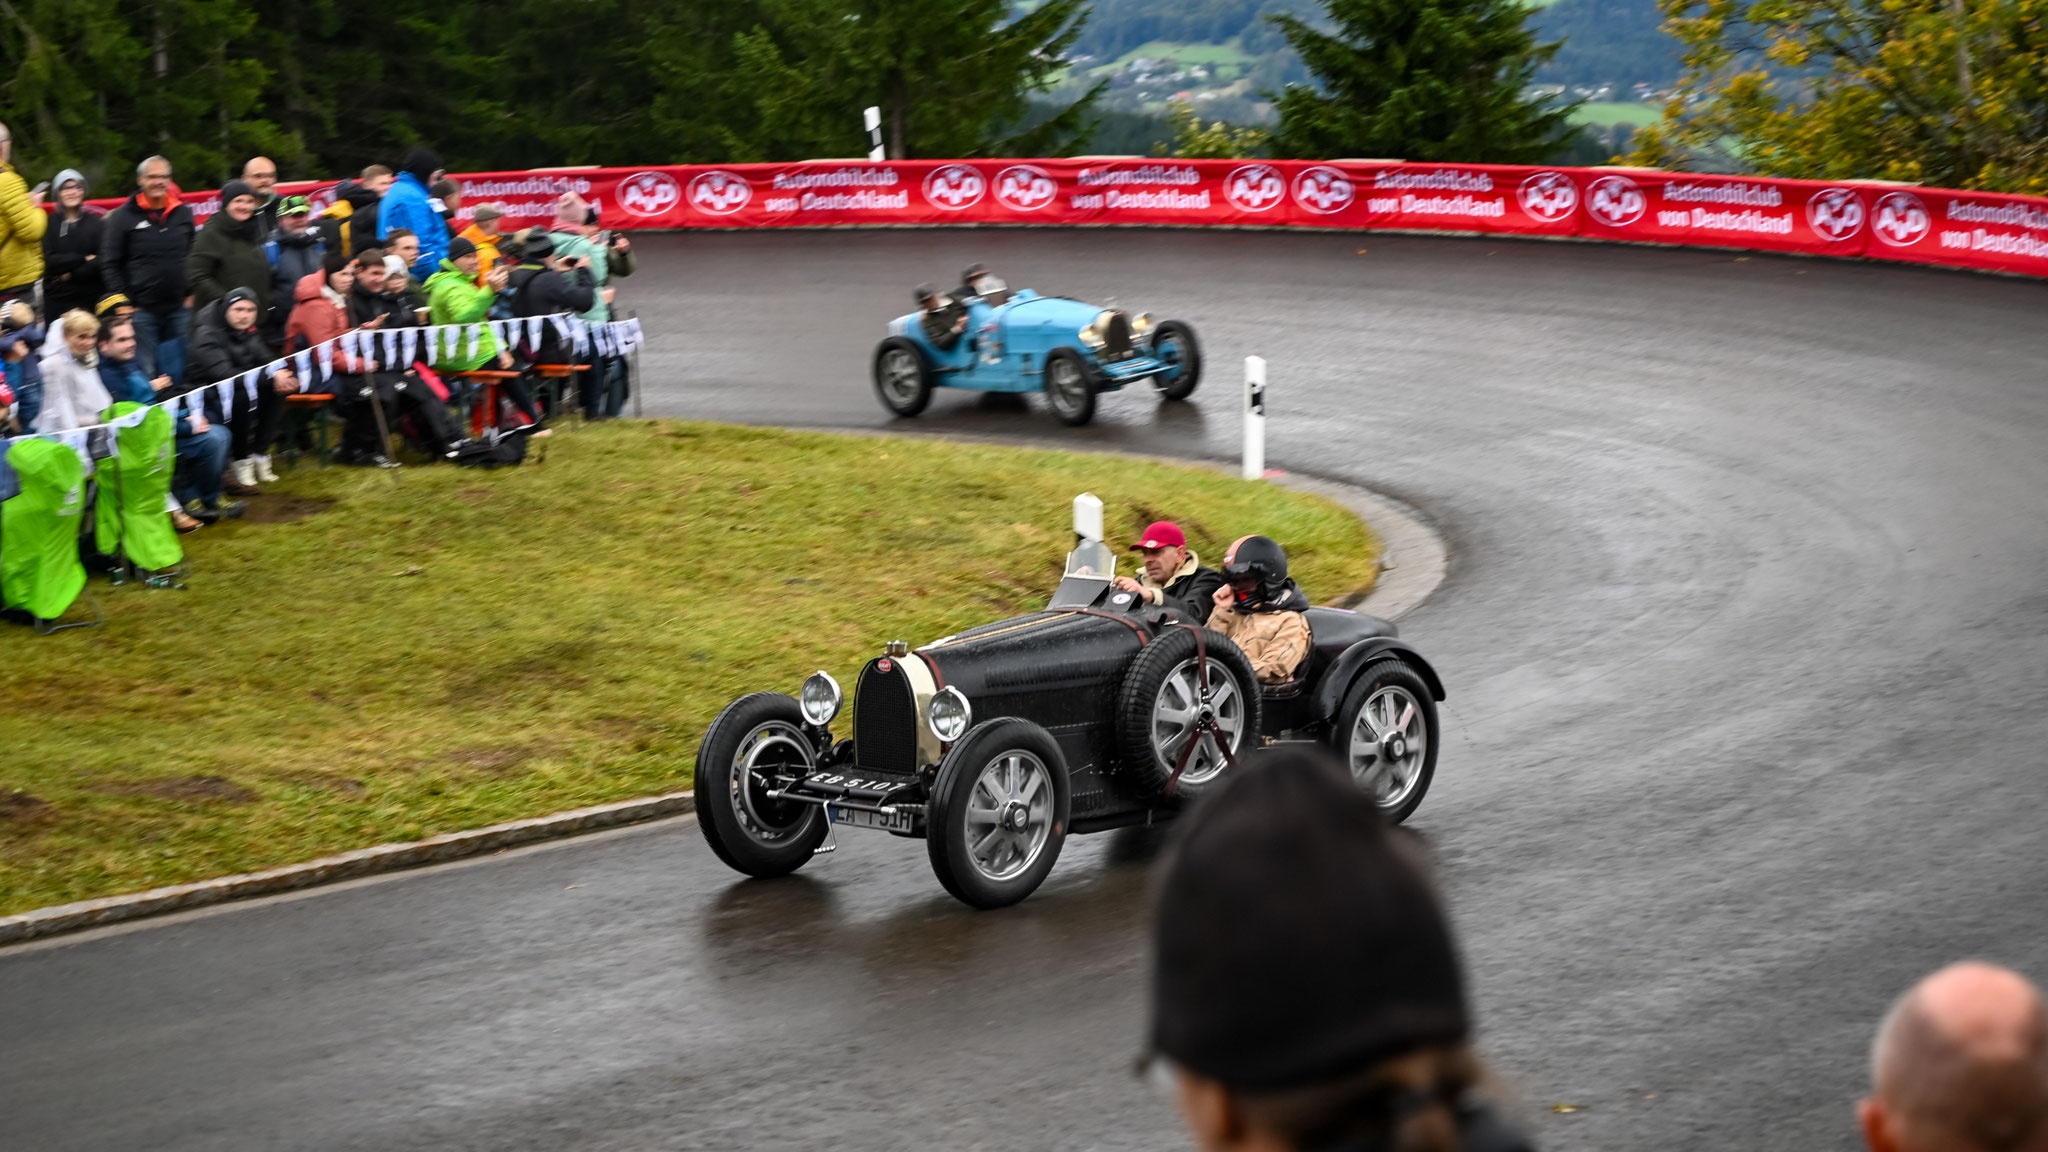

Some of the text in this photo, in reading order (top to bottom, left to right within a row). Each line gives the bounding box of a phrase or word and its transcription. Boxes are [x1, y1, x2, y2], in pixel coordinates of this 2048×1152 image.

[460, 175, 591, 198] Automobilclub
[772, 166, 899, 190] Automobilclub
[1077, 165, 1200, 186] Automobilclub
[1374, 169, 1494, 193] Automobilclub
[764, 188, 909, 213] von Deutschland
[1069, 188, 1211, 210] von Deutschland
[1367, 193, 1506, 218] von Deutschland
[1663, 181, 1783, 208] Automobilclub
[1657, 206, 1793, 235] von Deutschland
[1946, 199, 2048, 231] Automobilclu
[1940, 229, 1971, 249] von
[811, 772, 907, 792] EB 5107
